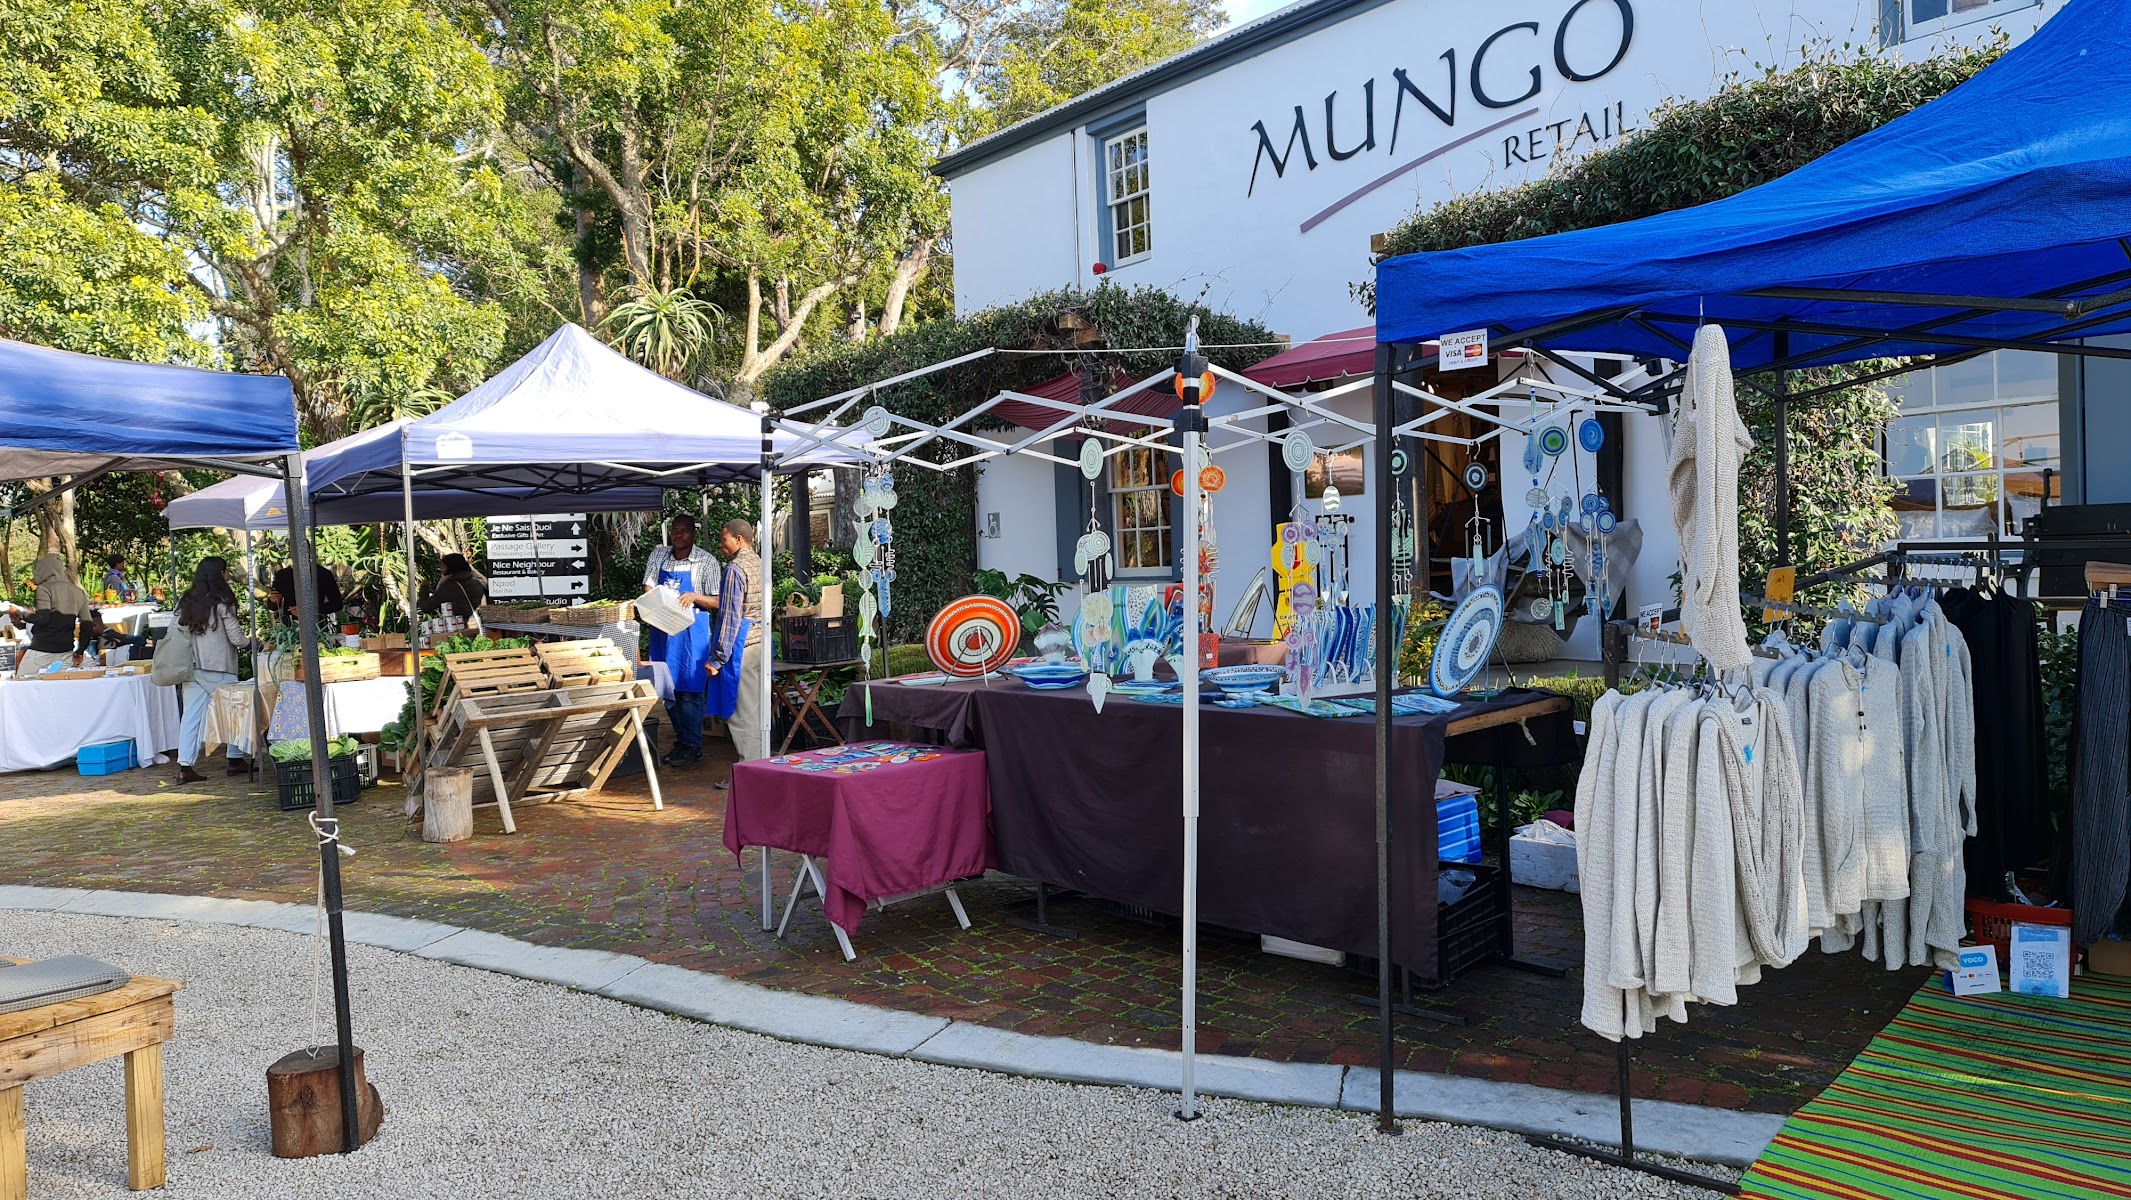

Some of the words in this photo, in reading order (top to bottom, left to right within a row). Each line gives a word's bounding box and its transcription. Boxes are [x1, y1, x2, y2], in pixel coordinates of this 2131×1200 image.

[1248, 0, 1634, 198] MUNGO
[1502, 101, 1636, 168] RETAIL
[1455, 334, 1486, 345] ACCEPT
[1445, 349, 1462, 358] VISA
[492, 580, 515, 589] Npod
